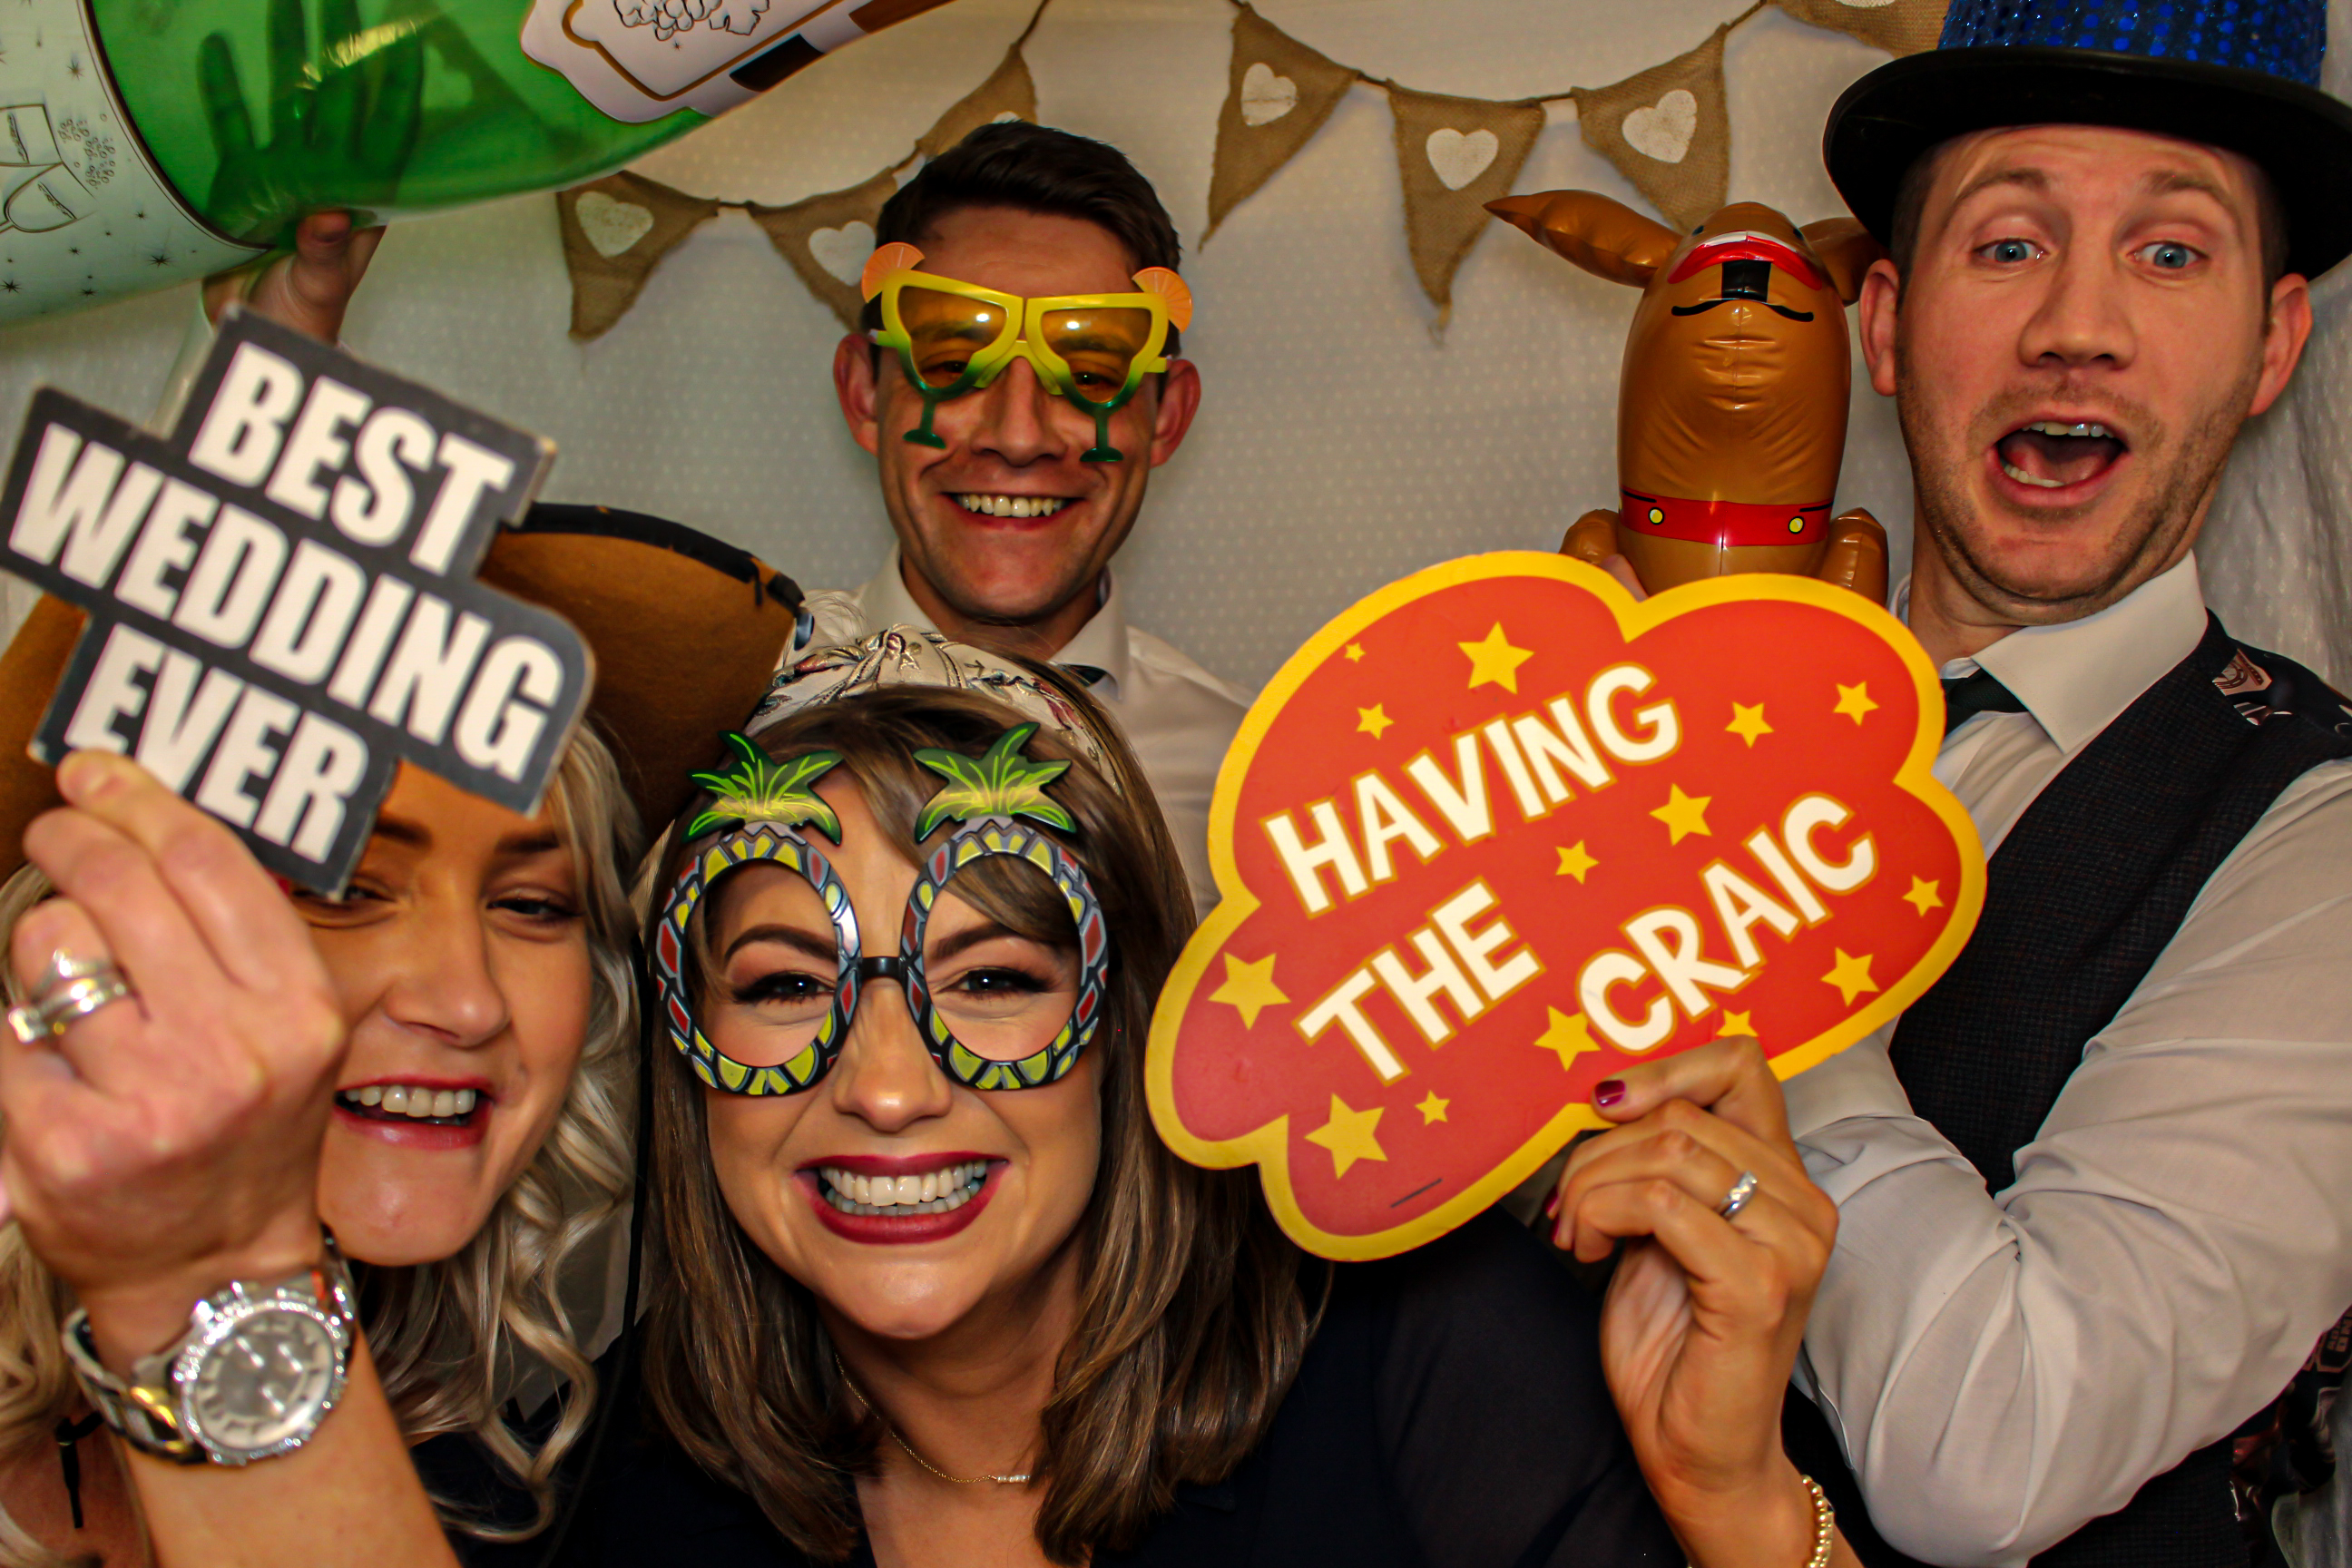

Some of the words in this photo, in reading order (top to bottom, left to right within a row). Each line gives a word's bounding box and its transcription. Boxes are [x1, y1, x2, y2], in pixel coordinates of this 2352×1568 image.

[188, 340, 515, 577] BEST
[7, 421, 564, 783] WEDDING
[64, 622, 369, 865] EVER
[1263, 662, 1681, 918] HAVING
[1295, 877, 1544, 1084] THE
[1576, 793, 1877, 1054] CRAIC
